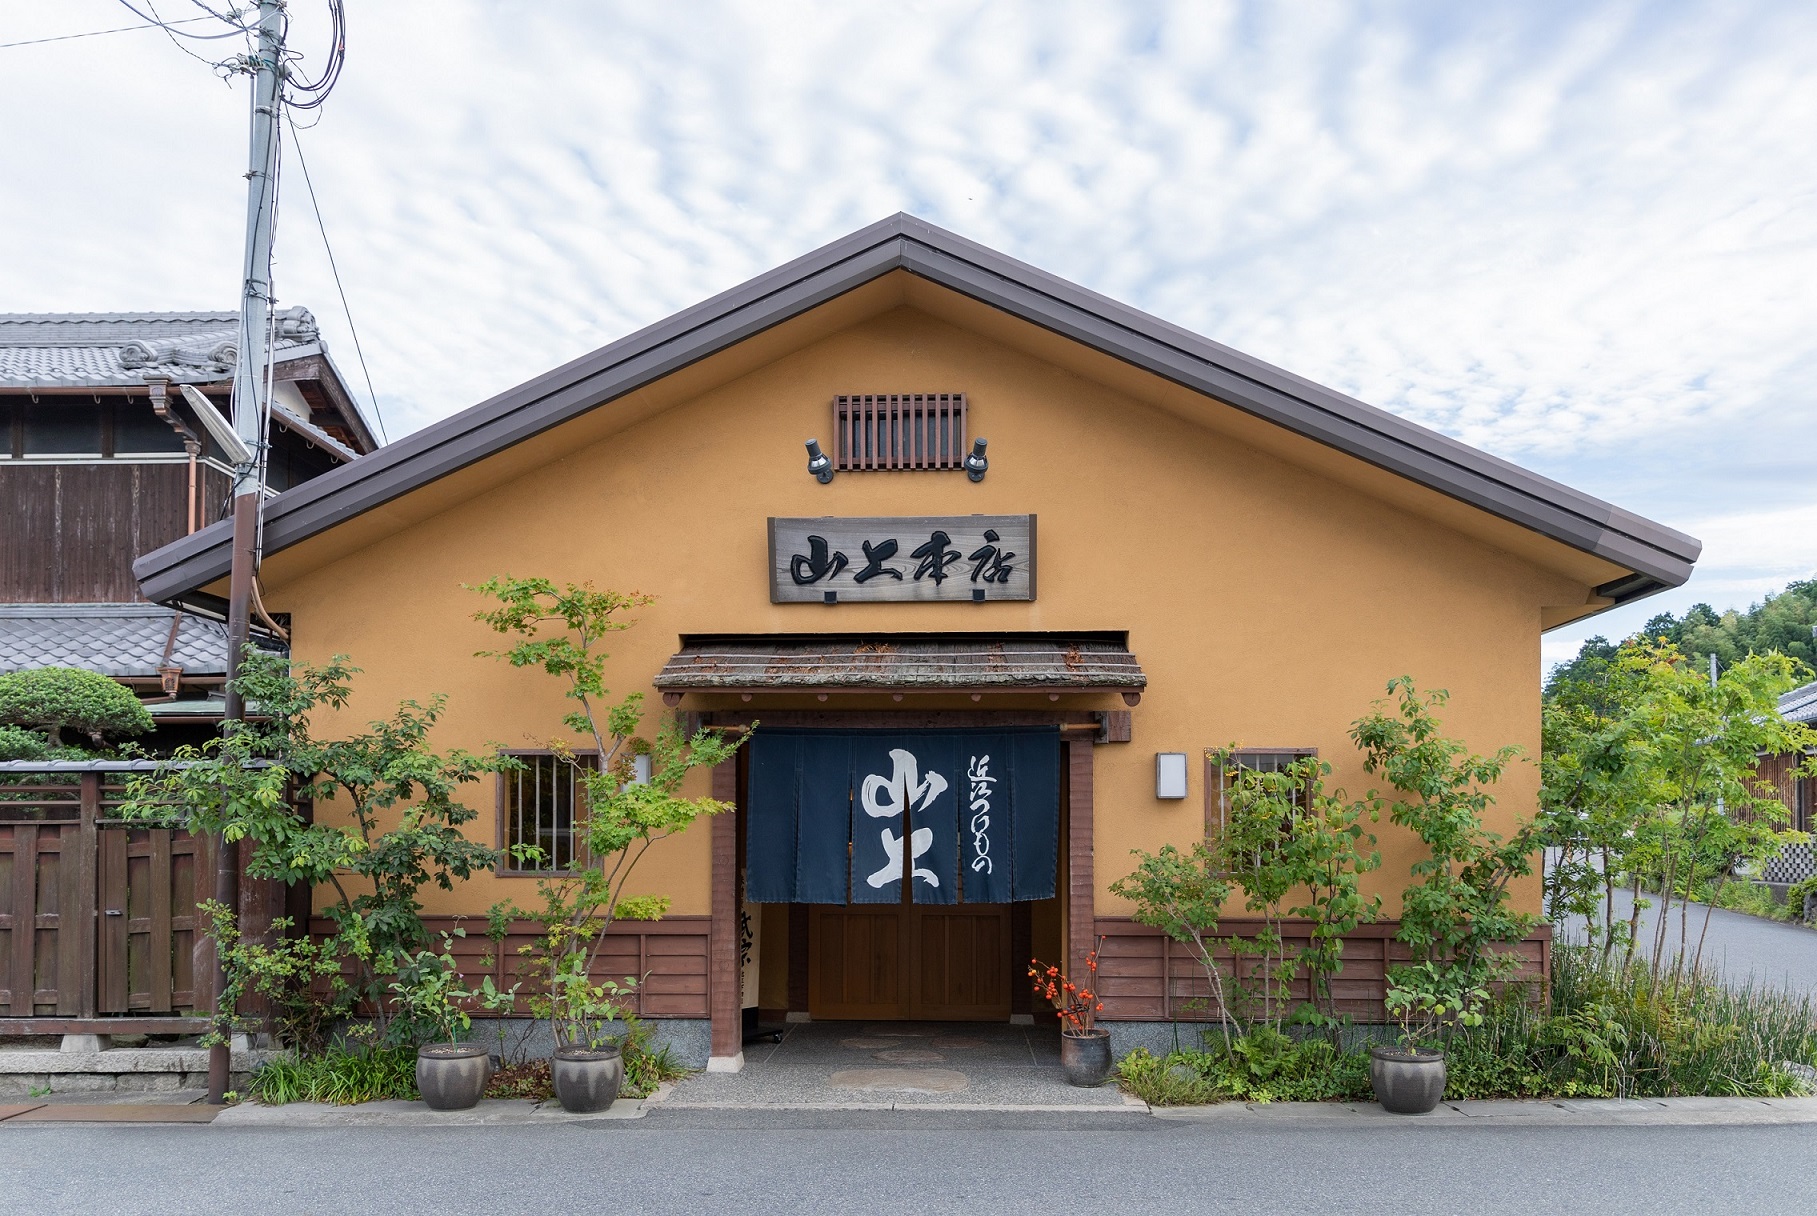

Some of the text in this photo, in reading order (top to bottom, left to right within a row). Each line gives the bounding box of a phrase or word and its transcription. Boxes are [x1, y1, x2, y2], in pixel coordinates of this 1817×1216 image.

[861, 748, 949, 889] 山上
[967, 754, 998, 875] 近江つけもの
